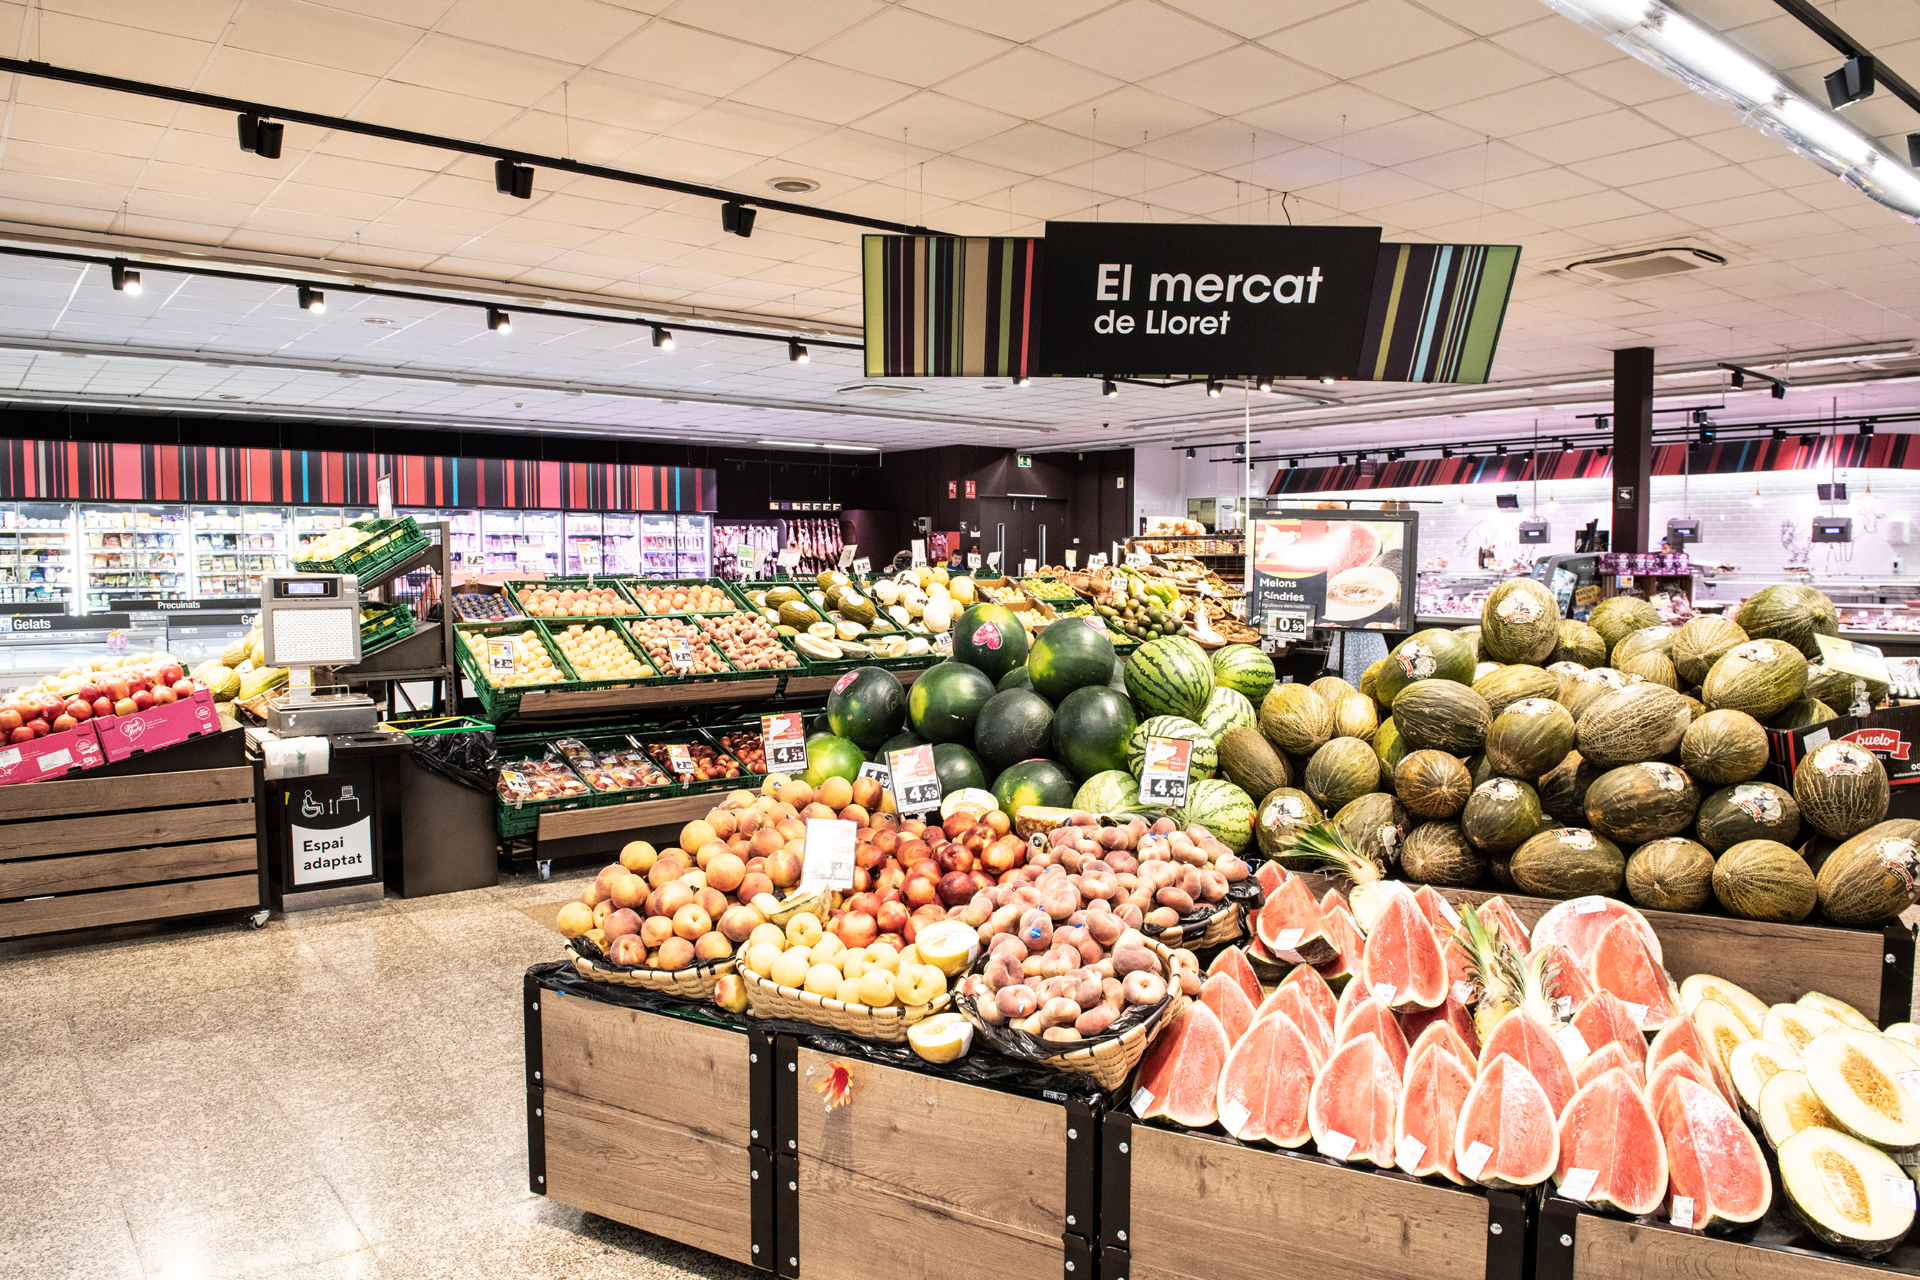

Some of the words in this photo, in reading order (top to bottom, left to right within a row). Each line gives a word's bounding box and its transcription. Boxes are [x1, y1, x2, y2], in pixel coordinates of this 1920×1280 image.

[1096, 263, 1133, 301] El
[1149, 266, 1324, 303] mercat
[1094, 309, 1135, 334] de
[1145, 309, 1231, 335] Lloret
[1259, 577, 1297, 588] Melons
[1263, 591, 1305, 602] Síndries
[157, 601, 201, 610] Precuinats
[13, 619, 51, 630] Gelats
[1279, 618, 1304, 632] 0,99
[1856, 733, 1895, 746] buelo
[777, 748, 804, 763] 4,25
[909, 786, 938, 802] 4,49
[1154, 780, 1184, 797] 4,49
[303, 836, 344, 853] Espai
[303, 853, 363, 871] adaptat
